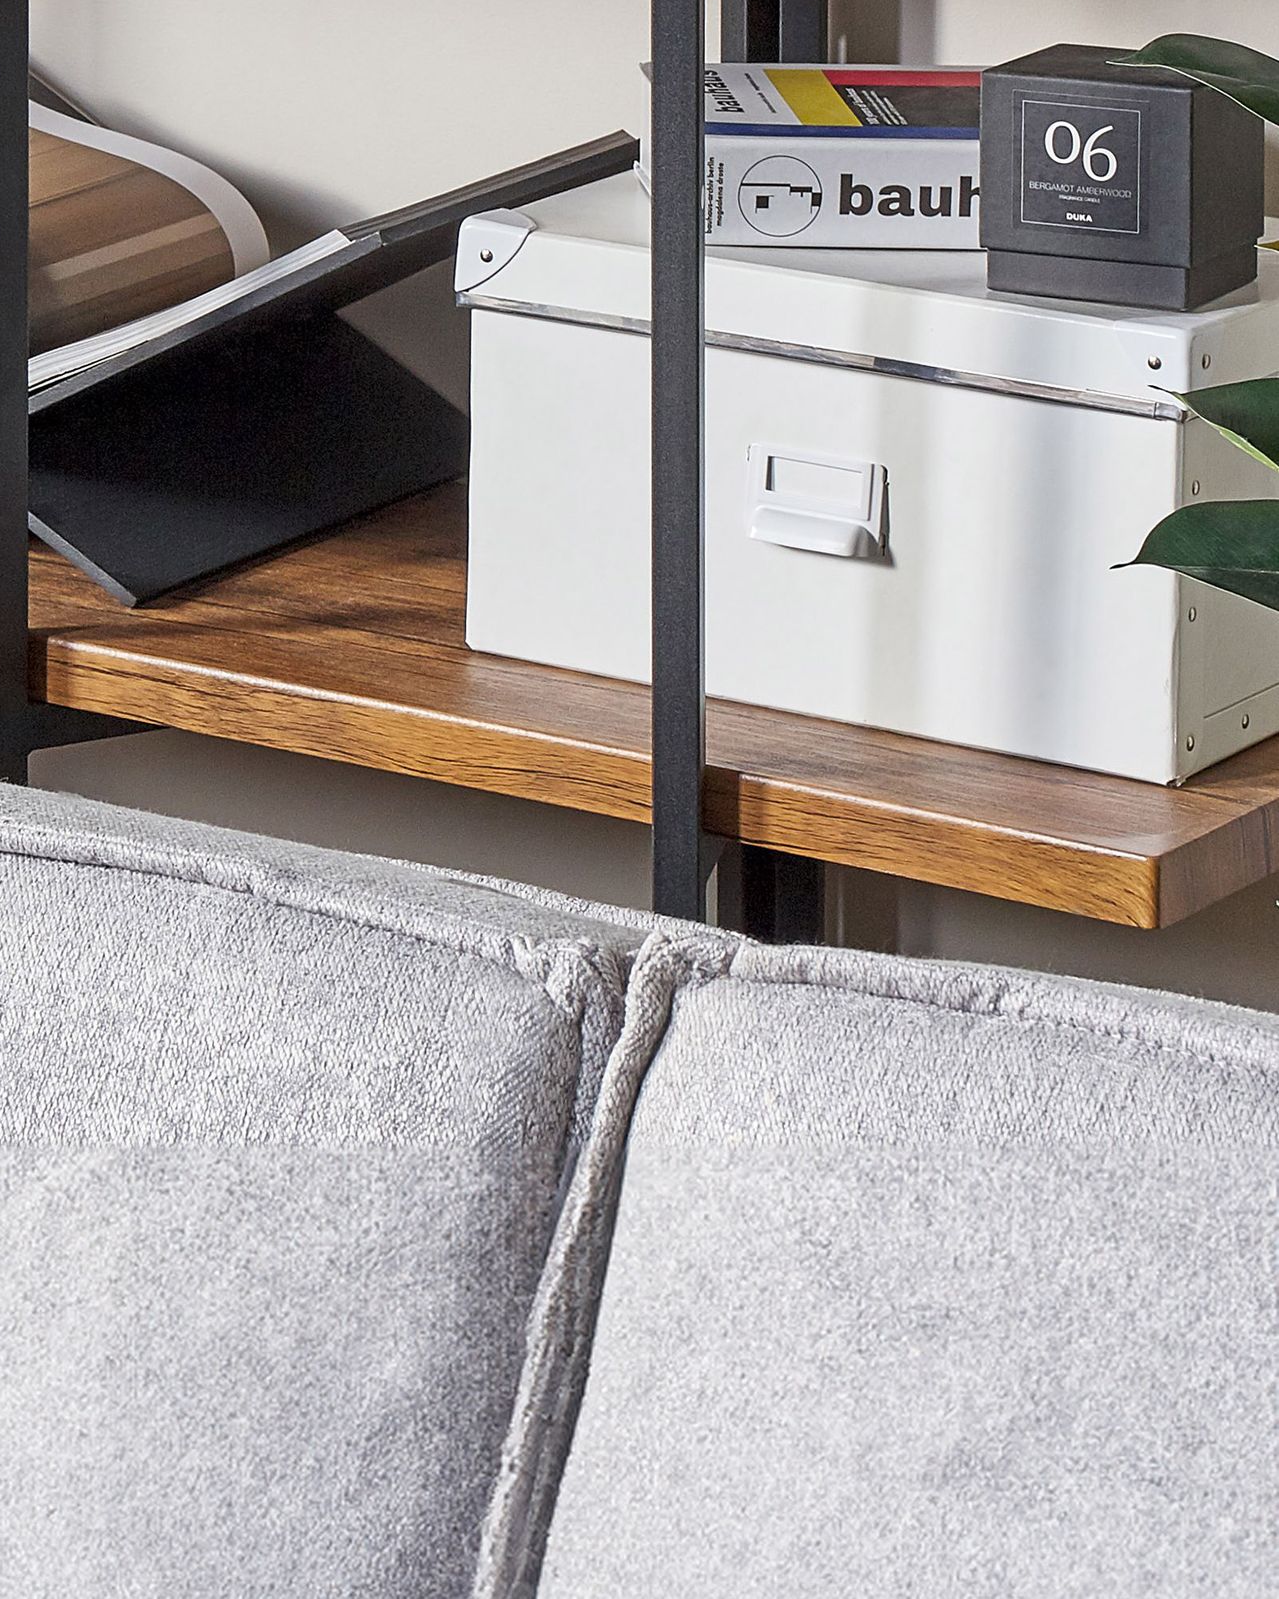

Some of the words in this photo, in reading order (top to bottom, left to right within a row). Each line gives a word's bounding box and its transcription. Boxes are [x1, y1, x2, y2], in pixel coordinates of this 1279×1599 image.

[1044, 120, 1118, 182] 06
[1029, 180, 1075, 192] BERGAMOT
[1076, 185, 1132, 198] AMBERWOOD
[1066, 212, 1093, 222] DUKA
